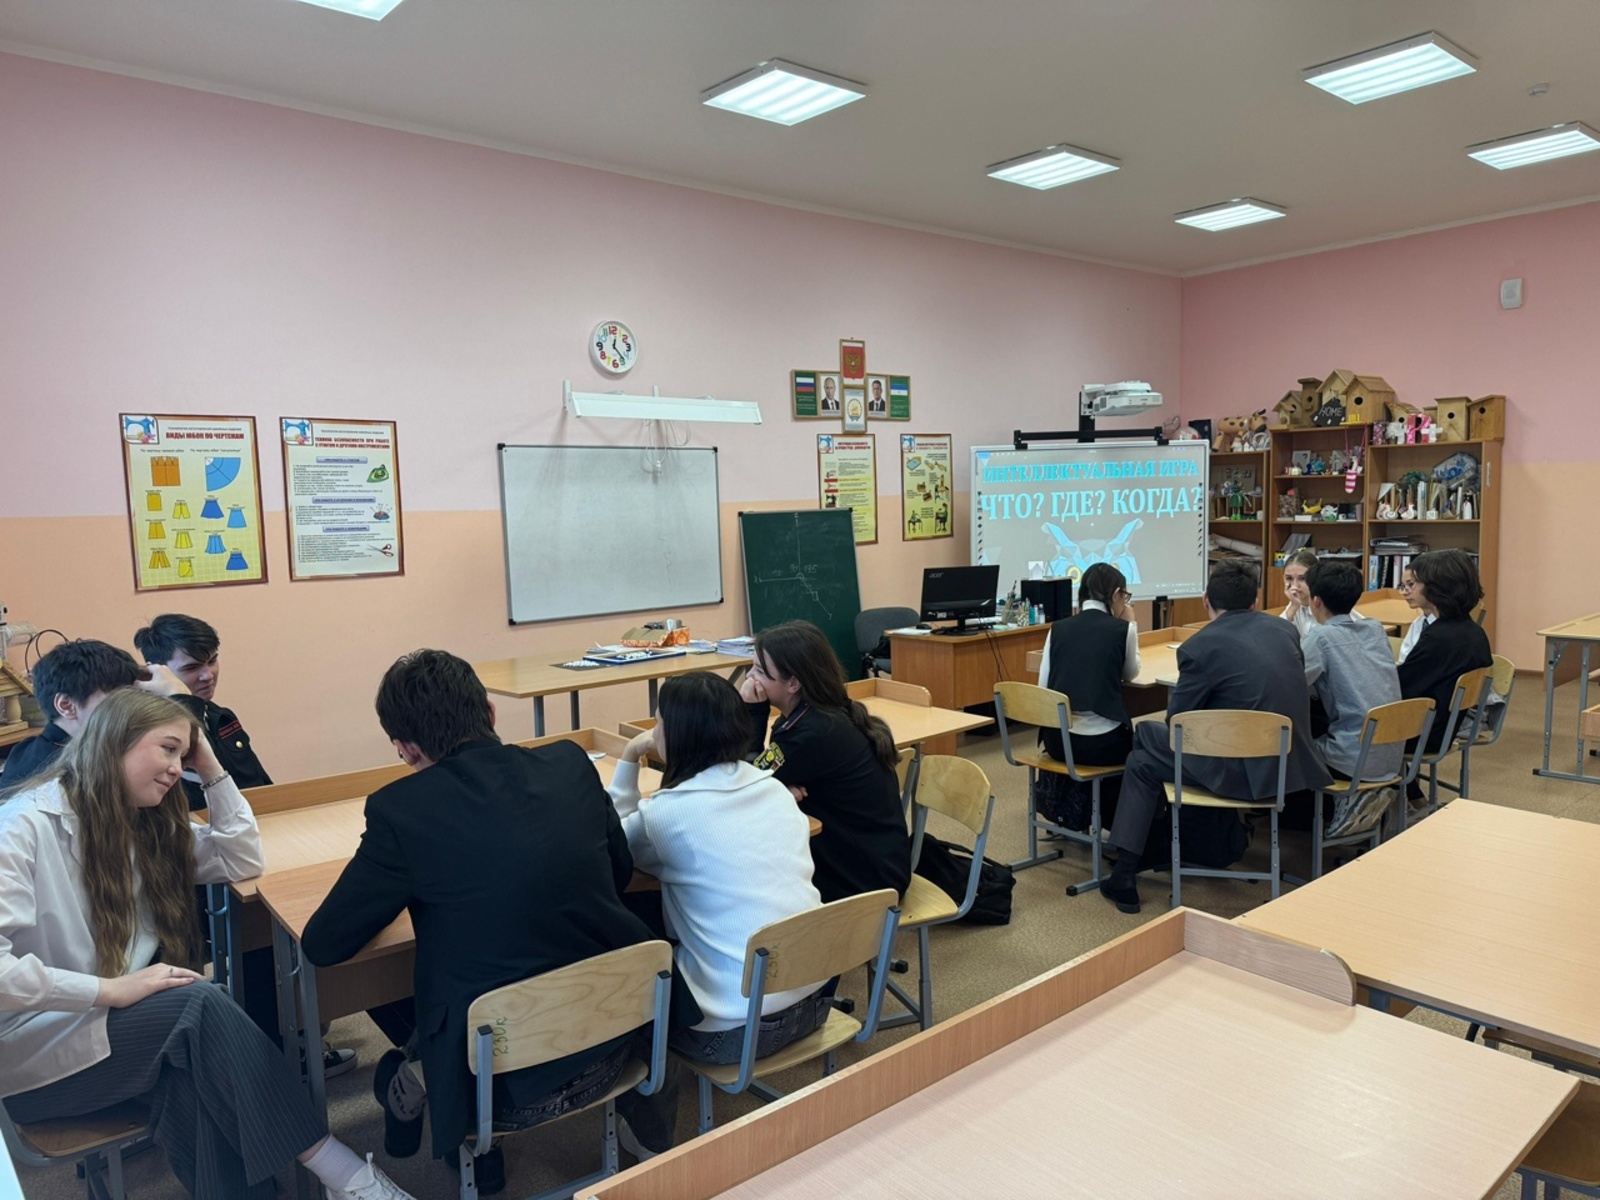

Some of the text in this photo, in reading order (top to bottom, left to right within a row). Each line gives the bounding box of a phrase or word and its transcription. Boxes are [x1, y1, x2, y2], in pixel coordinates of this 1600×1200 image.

[609, 326, 617, 335] 12
[622, 335, 628, 343] 2
[596, 342, 603, 351] 9
[626, 343, 631, 351] 3
[600, 351, 606, 359] 8
[612, 360, 619, 368] 6
[1318, 405, 1343, 417] HOME
[166, 432, 244, 440] ВИДЫ ЮБОК ПО ЧЕРТЕЖАМ
[982, 459, 1199, 483] ИНТЕЛЛЕКТУАЛЬНАЯ ИГРА
[980, 486, 1202, 523] ЧТО? ГДЕ? КОГДА?
